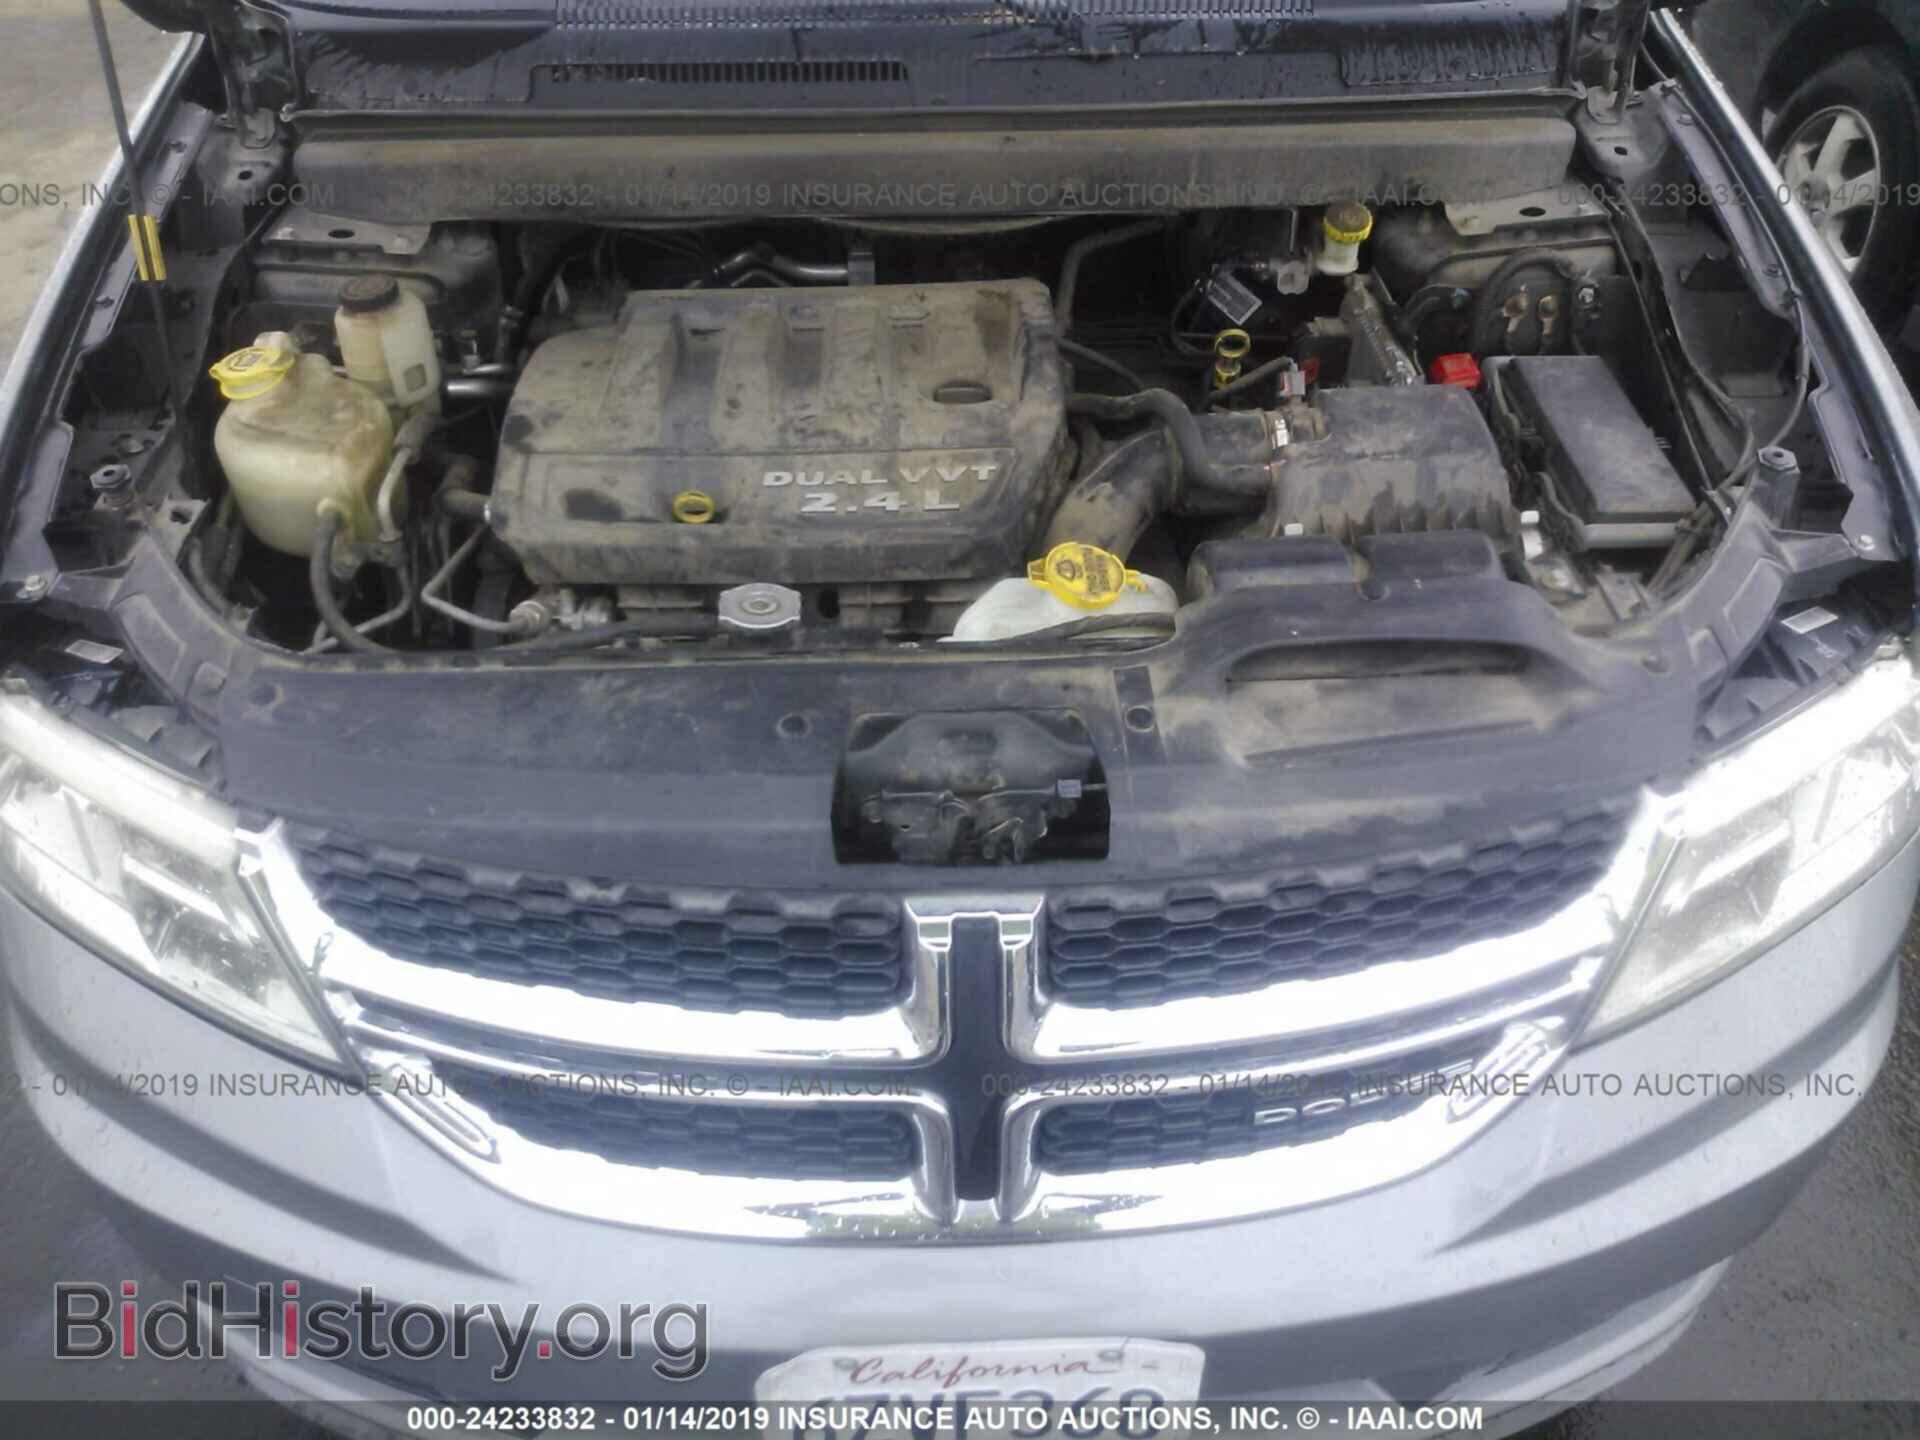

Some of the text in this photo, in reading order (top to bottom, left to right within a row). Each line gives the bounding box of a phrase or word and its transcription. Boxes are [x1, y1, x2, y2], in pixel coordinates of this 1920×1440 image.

[763, 465, 997, 487] DUAL VVT
[848, 1354, 1108, 1389] California
